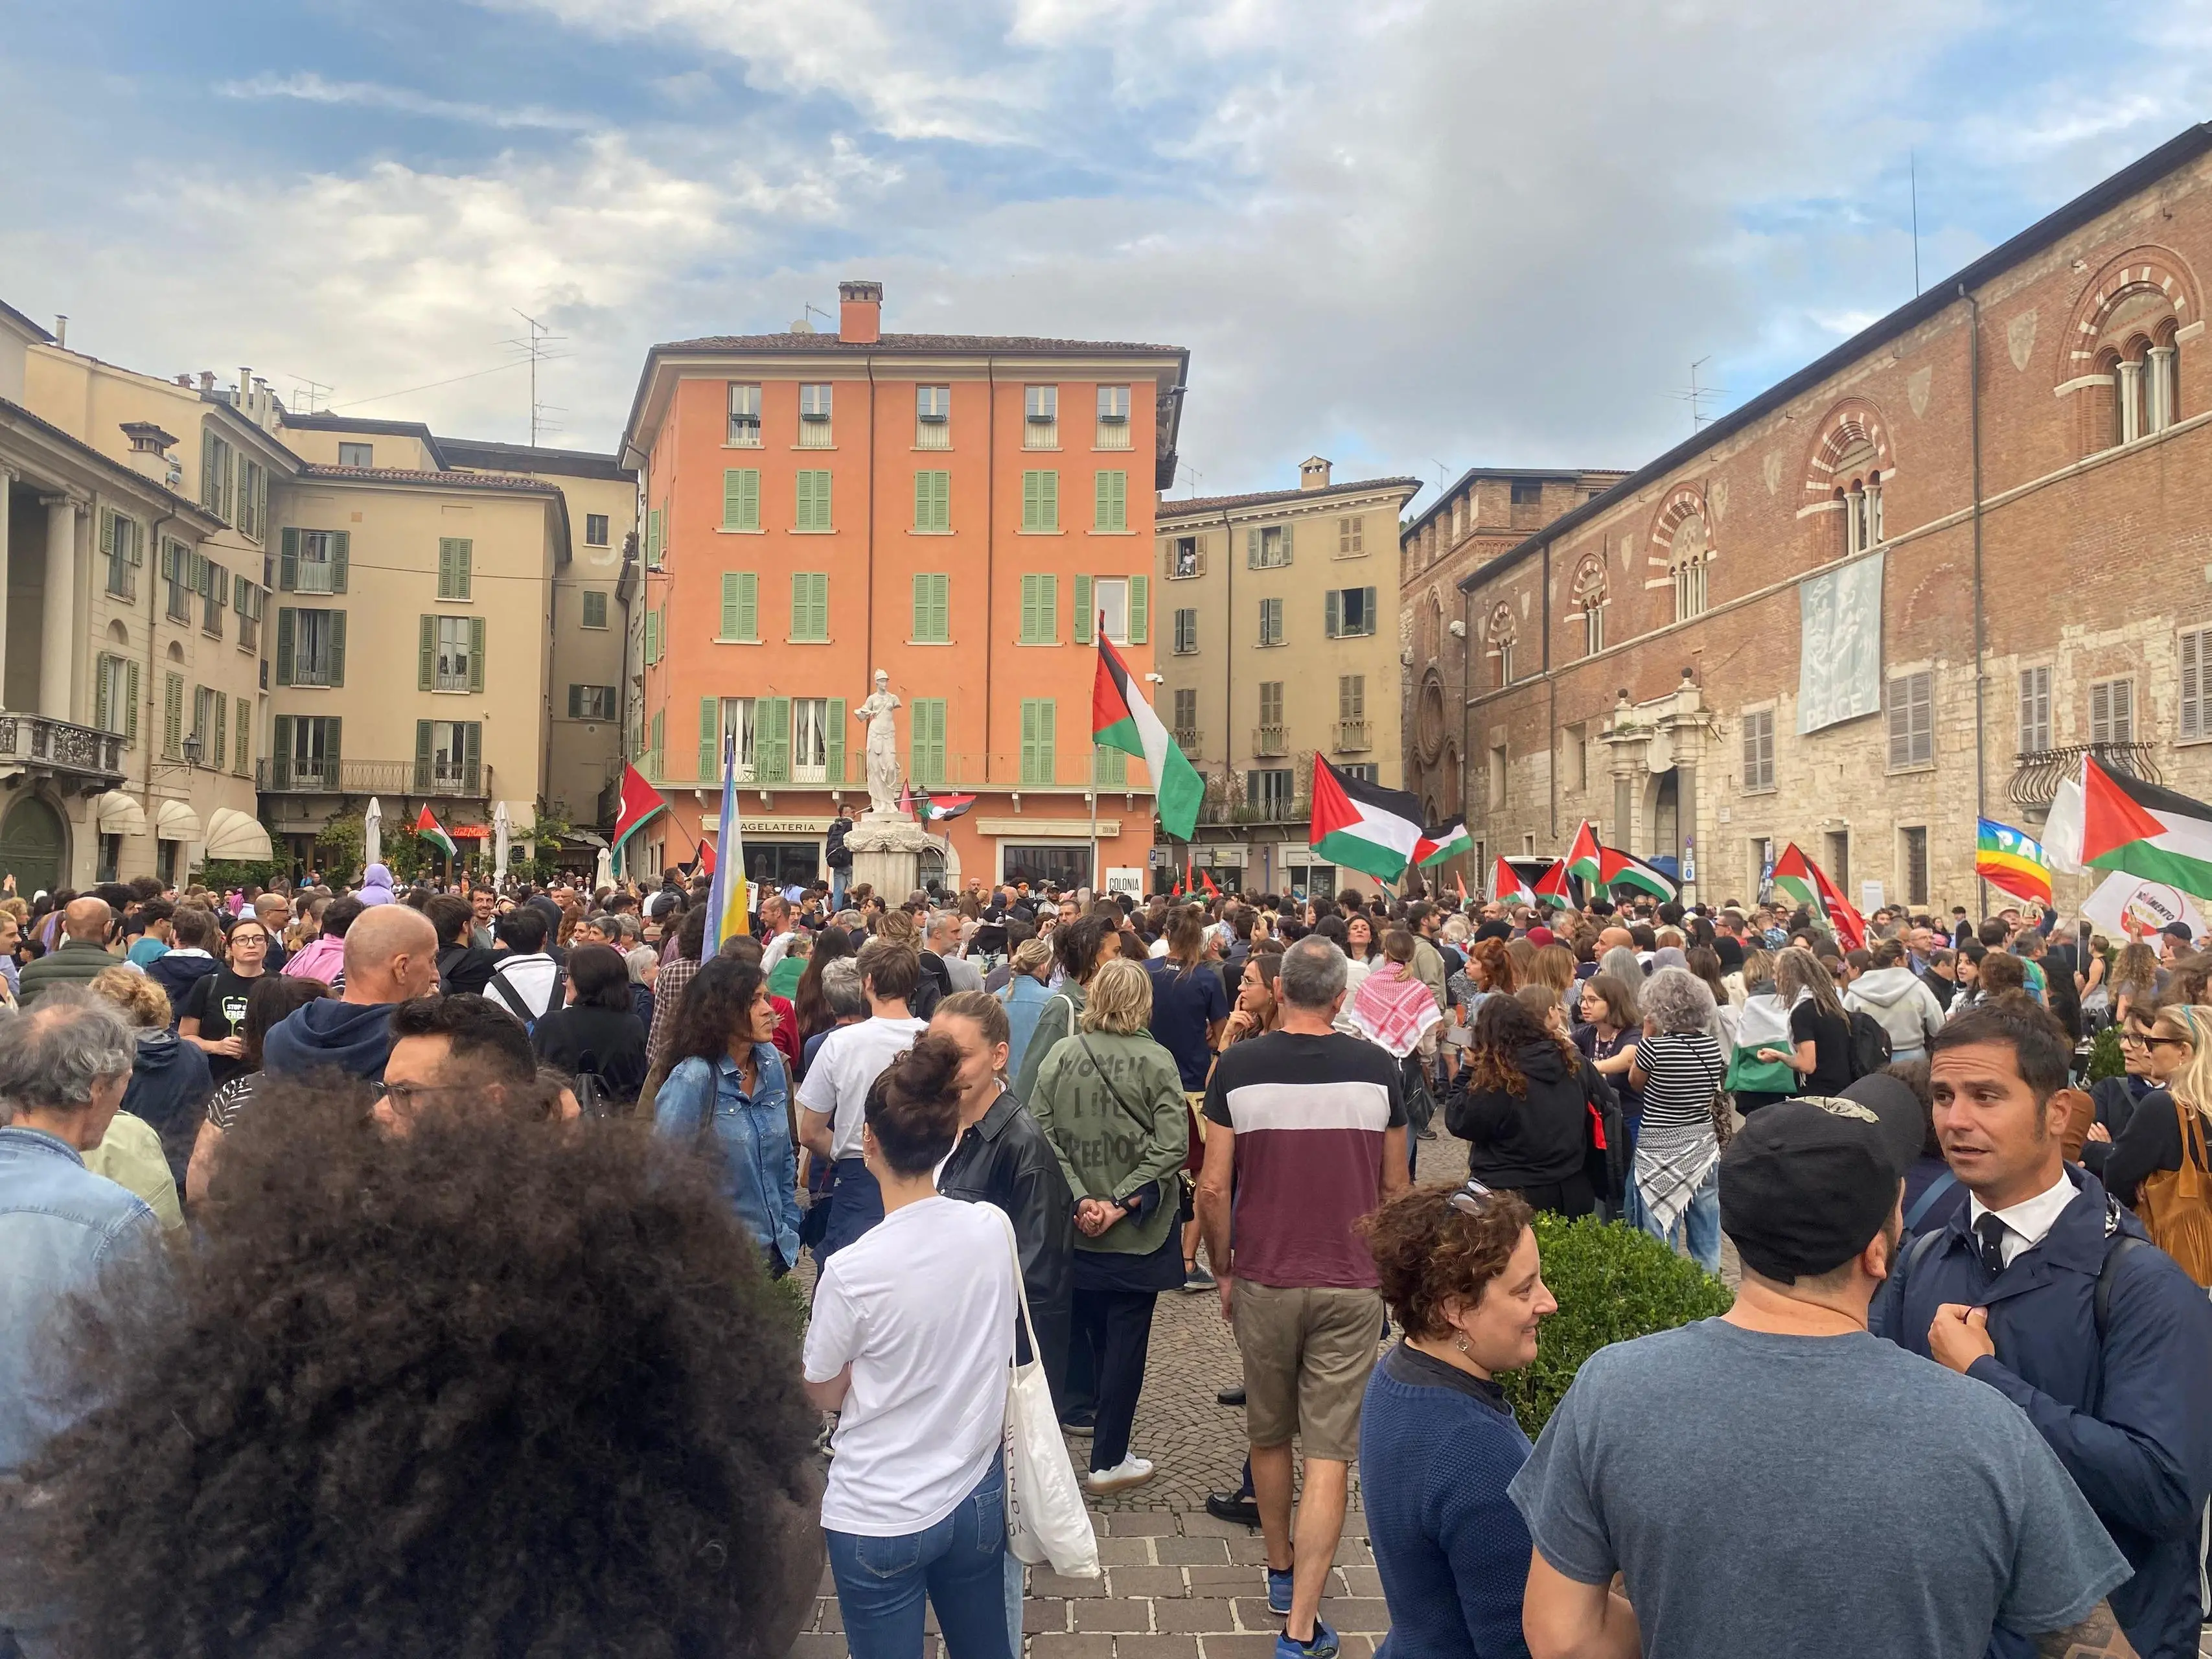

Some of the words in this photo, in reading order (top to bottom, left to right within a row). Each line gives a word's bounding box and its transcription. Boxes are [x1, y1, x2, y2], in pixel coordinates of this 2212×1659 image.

[1806, 692, 1862, 732] PEACE
[1151, 851, 1155, 860] P
[1767, 866, 1772, 878] P
[1109, 877, 1139, 891] COLONIA
